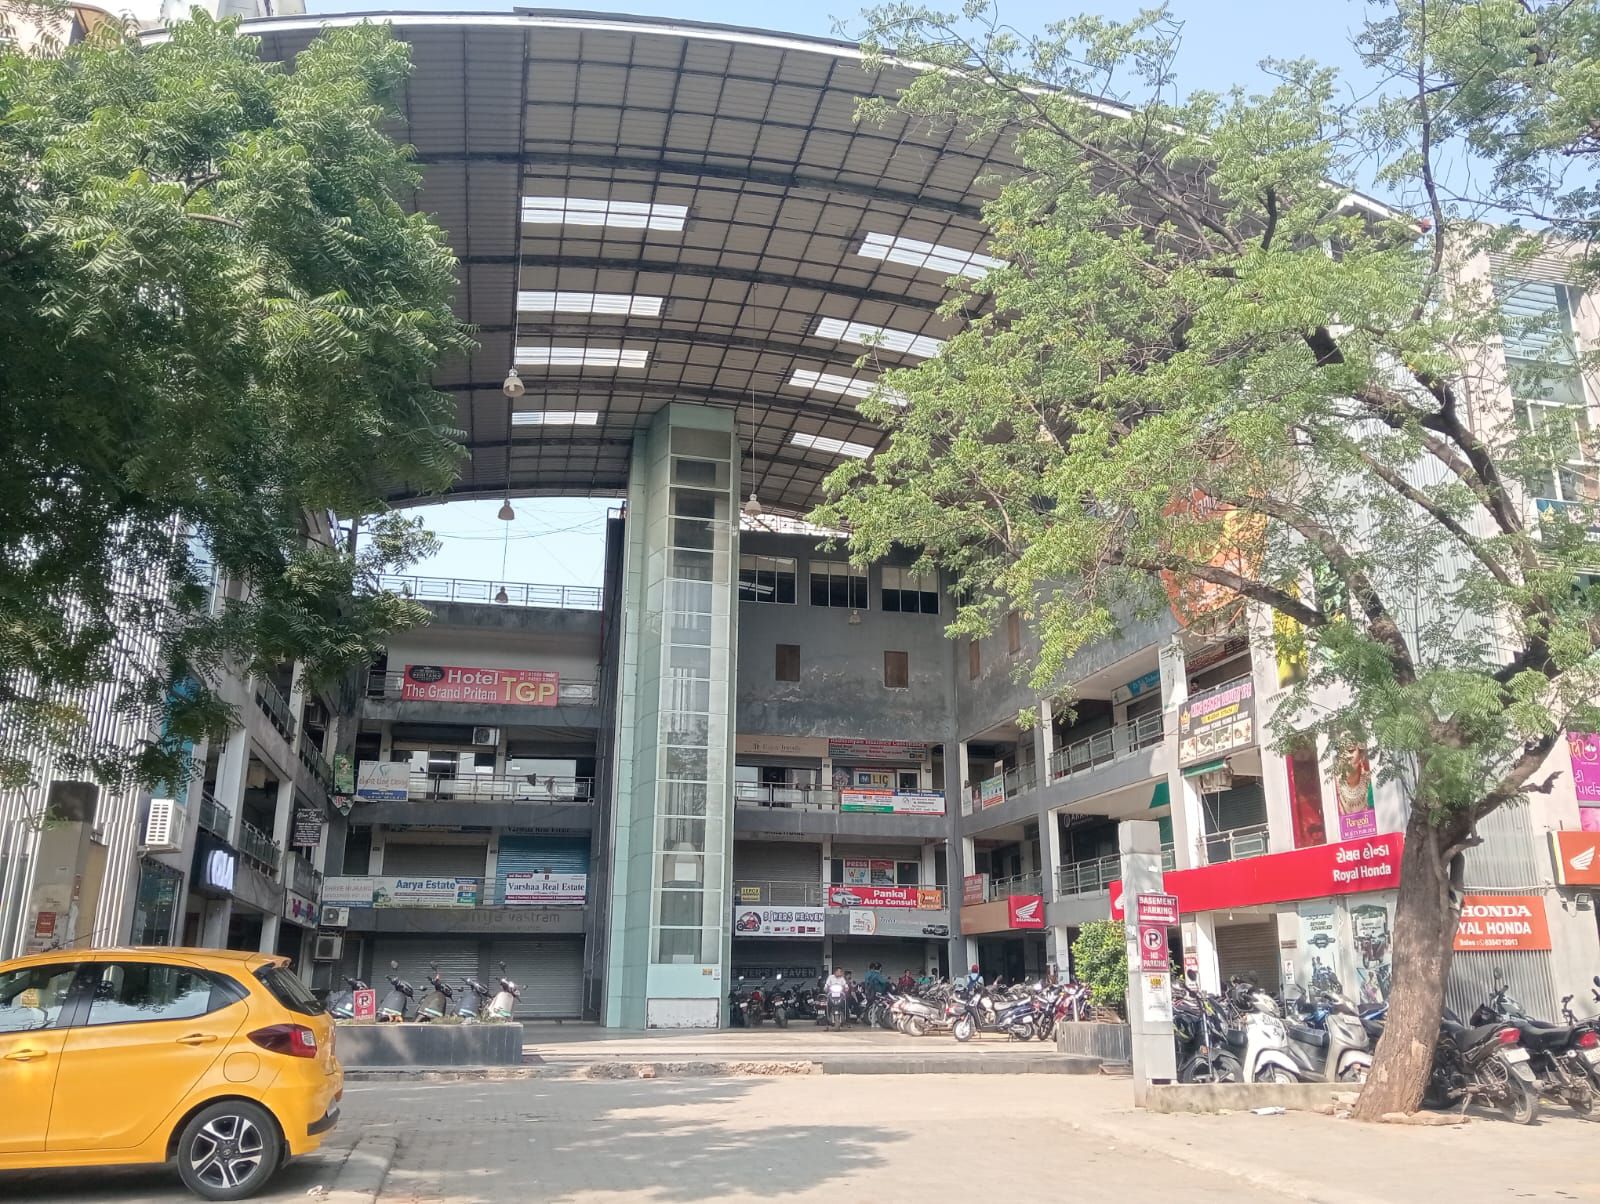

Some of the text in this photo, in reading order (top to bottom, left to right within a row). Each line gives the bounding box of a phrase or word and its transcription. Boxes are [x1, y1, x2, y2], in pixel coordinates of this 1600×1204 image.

[447, 669, 499, 685] Hotel
[405, 683, 497, 701] The Grand Pritam
[501, 676, 556, 703] TGP
[872, 774, 890, 785] LIC
[1335, 842, 1390, 863] રોયલ હોન્ડા
[1332, 862, 1392, 883] Royal Honda
[395, 879, 423, 891] Aarya
[425, 879, 456, 890] Estate
[508, 882, 585, 891] Varshaa Real Estate
[873, 889, 907, 900] Pankaj
[885, 898, 917, 906] Consult
[1138, 896, 1176, 905] BASEMENT
[1143, 906, 1173, 914] PARKING
[1461, 905, 1533, 917] HONDA
[795, 911, 824, 922] HEAVEN
[1456, 921, 1532, 935] YAL HONDA
[1143, 959, 1167, 967] PARKING
